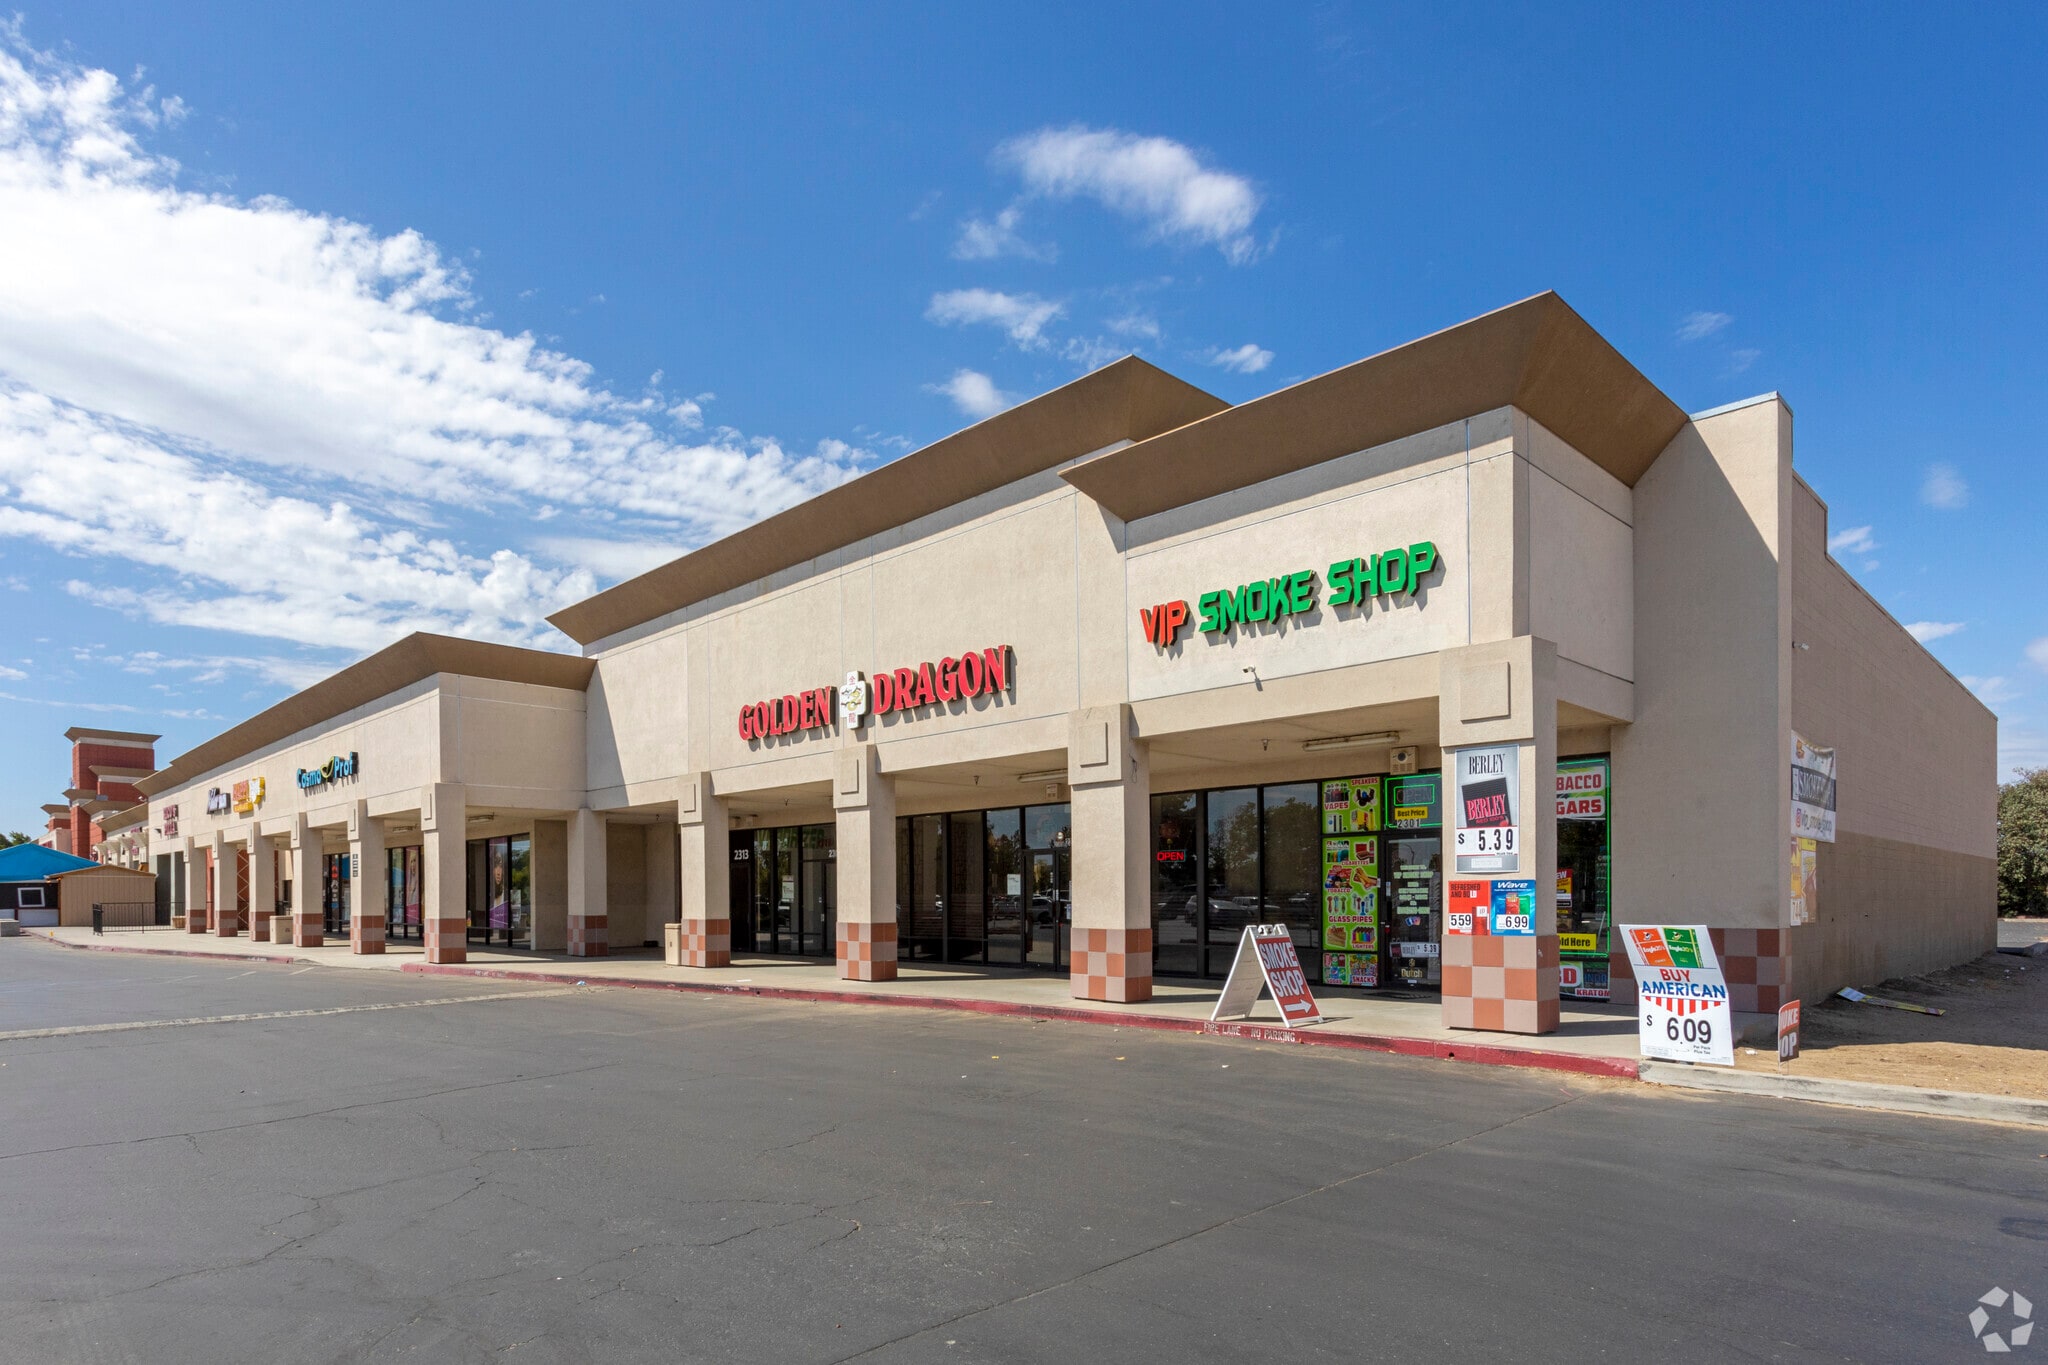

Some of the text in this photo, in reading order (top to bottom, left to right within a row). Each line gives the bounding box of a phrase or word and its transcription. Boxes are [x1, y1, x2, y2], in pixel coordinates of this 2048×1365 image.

[1139, 541, 1437, 647] VIP SMOKE SHOP
[738, 644, 1011, 741] GOLDEN DRAGON
[1469, 753, 1506, 775] BERLEY
[1351, 777, 1379, 786] SPEAKERS
[1556, 774, 1602, 791] BACCO
[1324, 802, 1349, 810] VAPES
[1397, 808, 1425, 817] Best Price
[1466, 793, 1506, 820] BERLEY
[1556, 799, 1602, 815] GARS
[1397, 818, 1420, 828] 2301
[1458, 828, 1514, 851] $ 5.39
[734, 849, 749, 860] 2313
[1156, 851, 1185, 861] OPEN
[1450, 883, 1481, 891] REFRESHED
[1497, 881, 1528, 889] Wave
[1505, 915, 1528, 929] 6.99
[1571, 937, 1591, 947] Here
[1259, 942, 1299, 970] SMOKE
[1352, 976, 1375, 984] SNACKS
[1660, 968, 1691, 982] BUY
[1269, 969, 1305, 998] SHOP
[1641, 980, 1726, 999] AMERICAN
[1203, 1022, 1219, 1034] FIRE
[1222, 1024, 1241, 1036] LANE
[1250, 1027, 1261, 1038] NO
[1264, 1029, 1296, 1042] PARKING
[1646, 1014, 1712, 1045] $ 6.09
